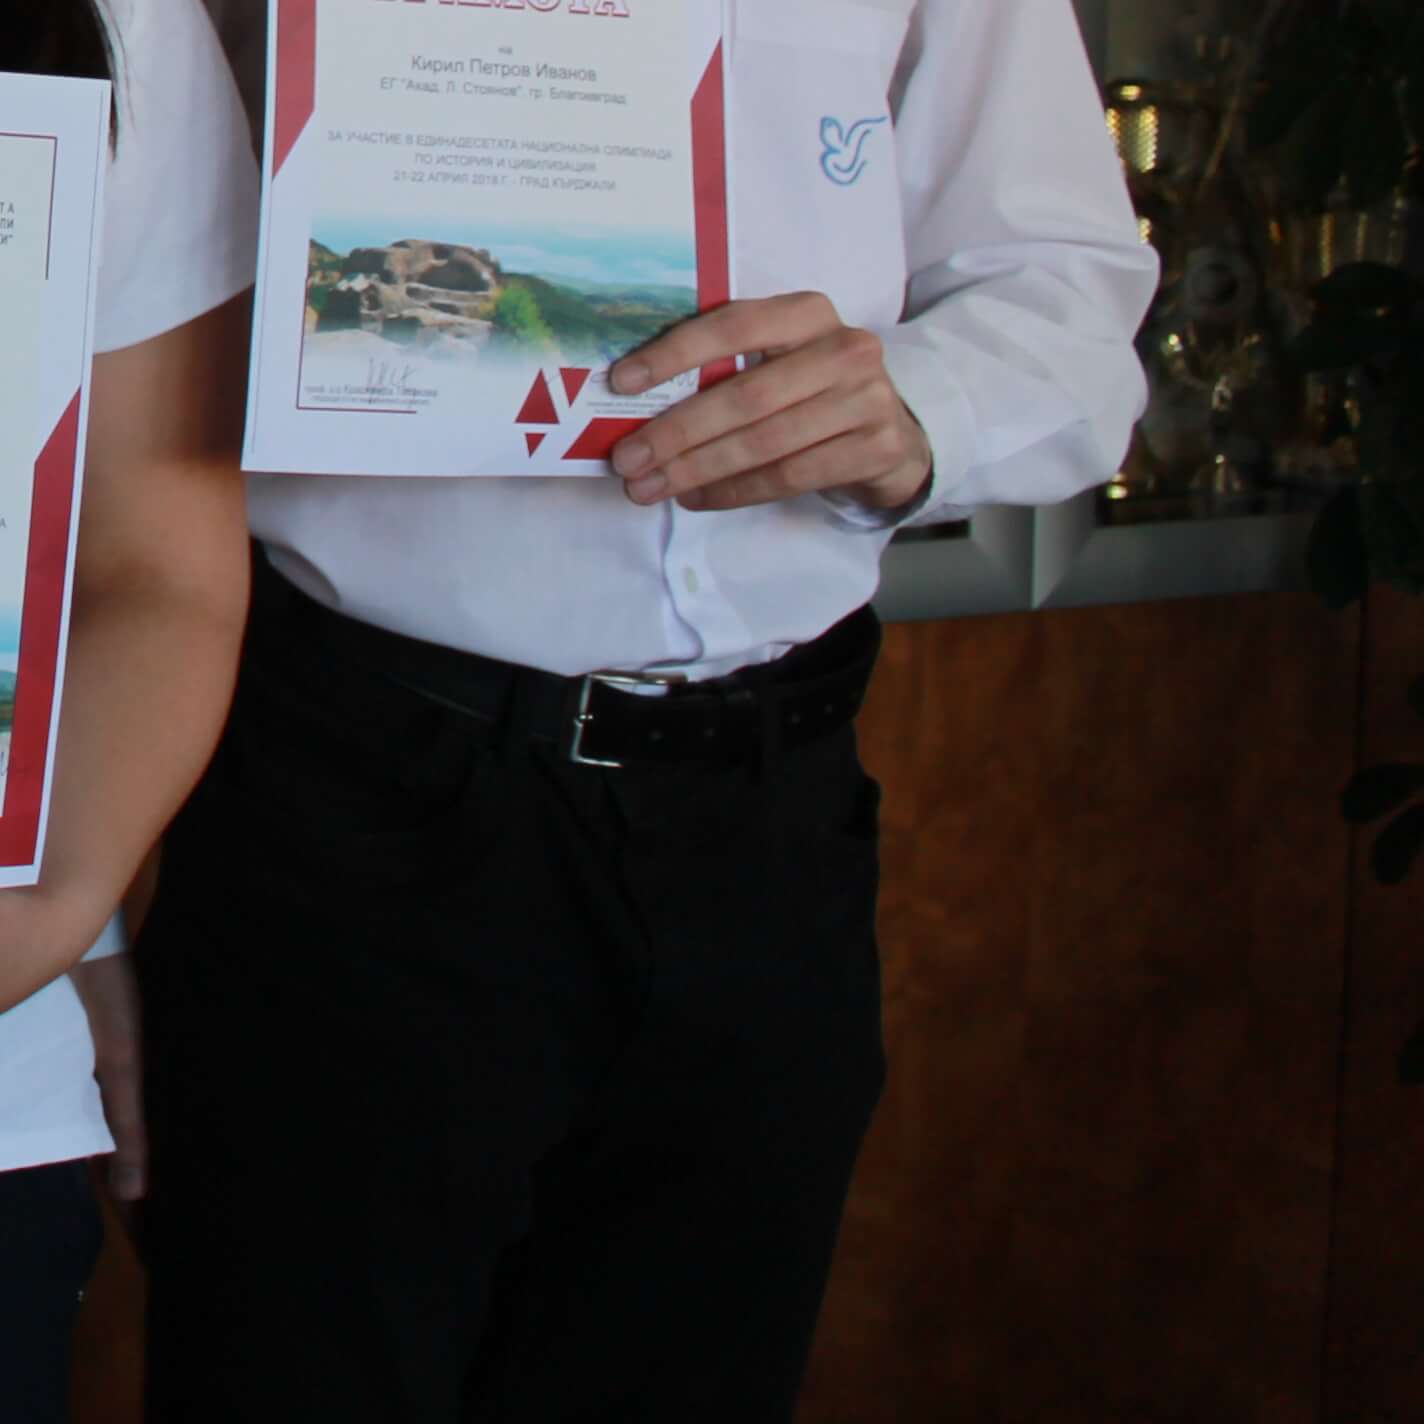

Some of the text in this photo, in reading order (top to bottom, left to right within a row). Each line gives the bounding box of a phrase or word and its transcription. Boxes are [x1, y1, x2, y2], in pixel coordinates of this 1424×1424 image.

[411, 55, 597, 83] Кирил Петров Иванов
